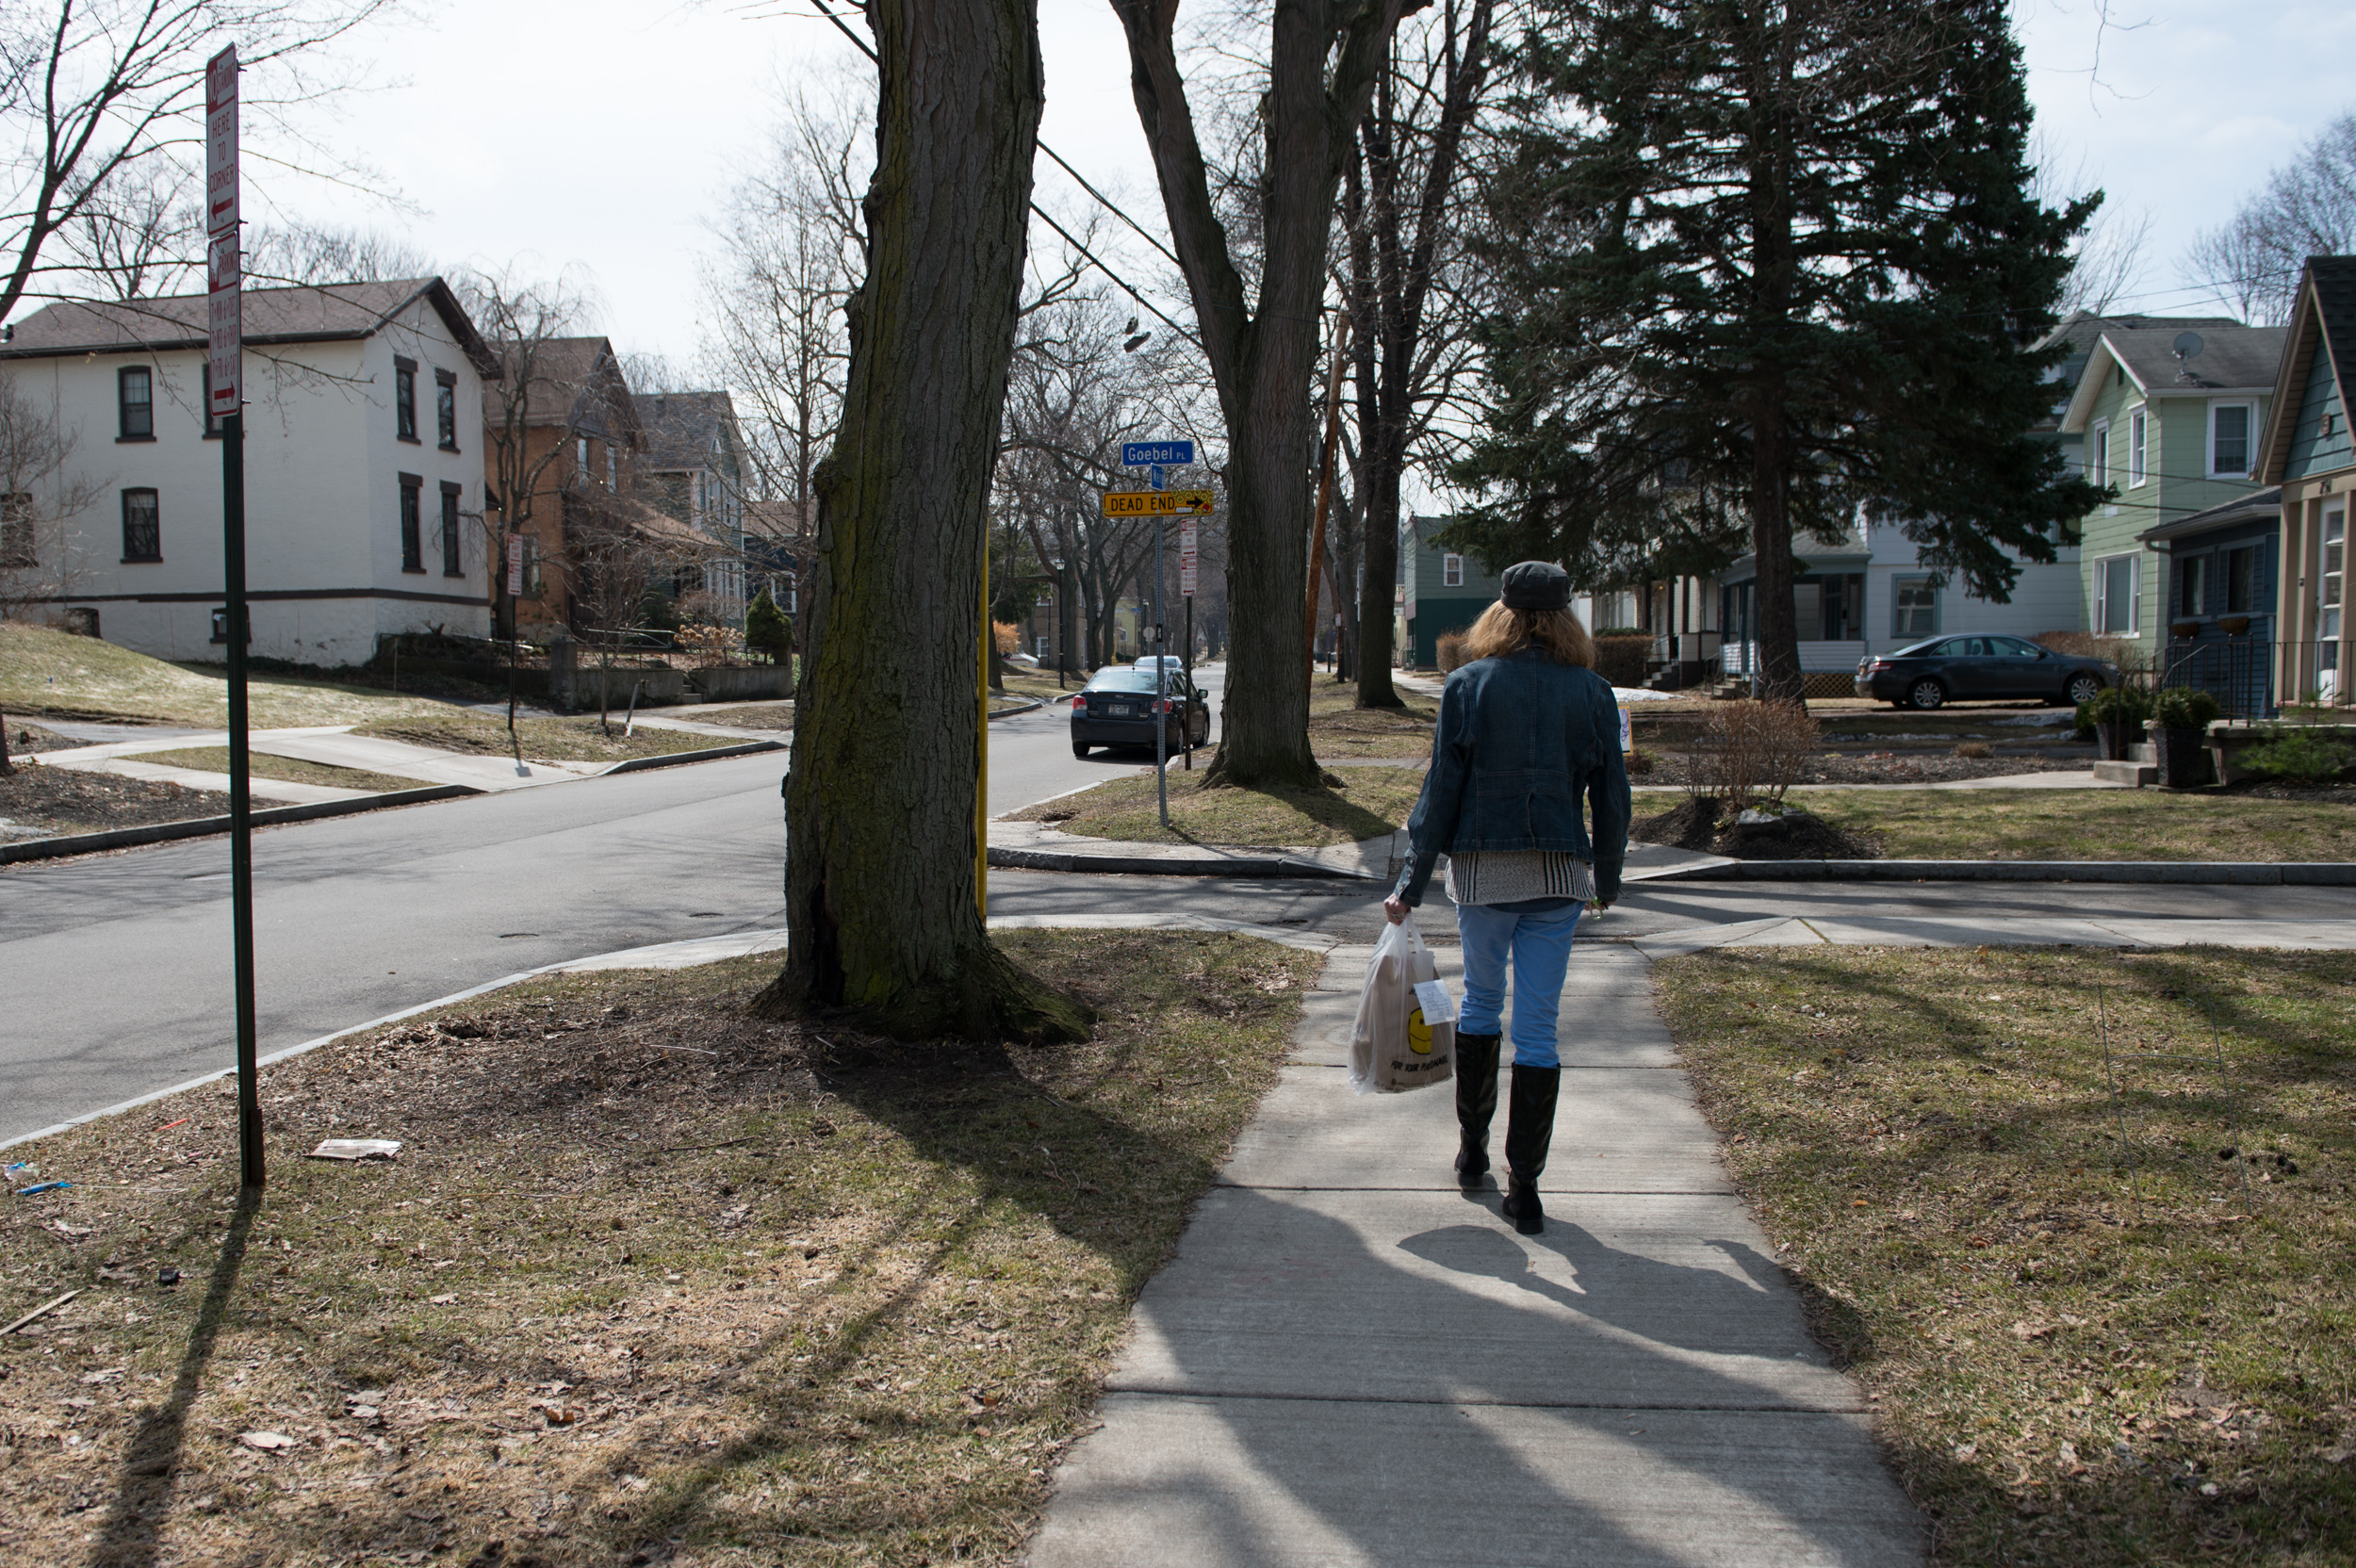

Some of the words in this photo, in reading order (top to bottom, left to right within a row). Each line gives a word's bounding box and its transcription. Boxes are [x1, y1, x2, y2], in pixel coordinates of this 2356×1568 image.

[207, 69, 218, 105] NO
[218, 62, 235, 94] STANDING
[212, 111, 231, 139] HERE
[218, 140, 226, 163] TO
[209, 163, 235, 194] CORNER
[219, 249, 236, 277] PARKING
[1128, 446, 1173, 462] Goebel
[1176, 451, 1186, 460] PL
[1110, 498, 1143, 512] DEAD
[1151, 497, 1175, 511] END
[1390, 1060, 1403, 1070] FOR
